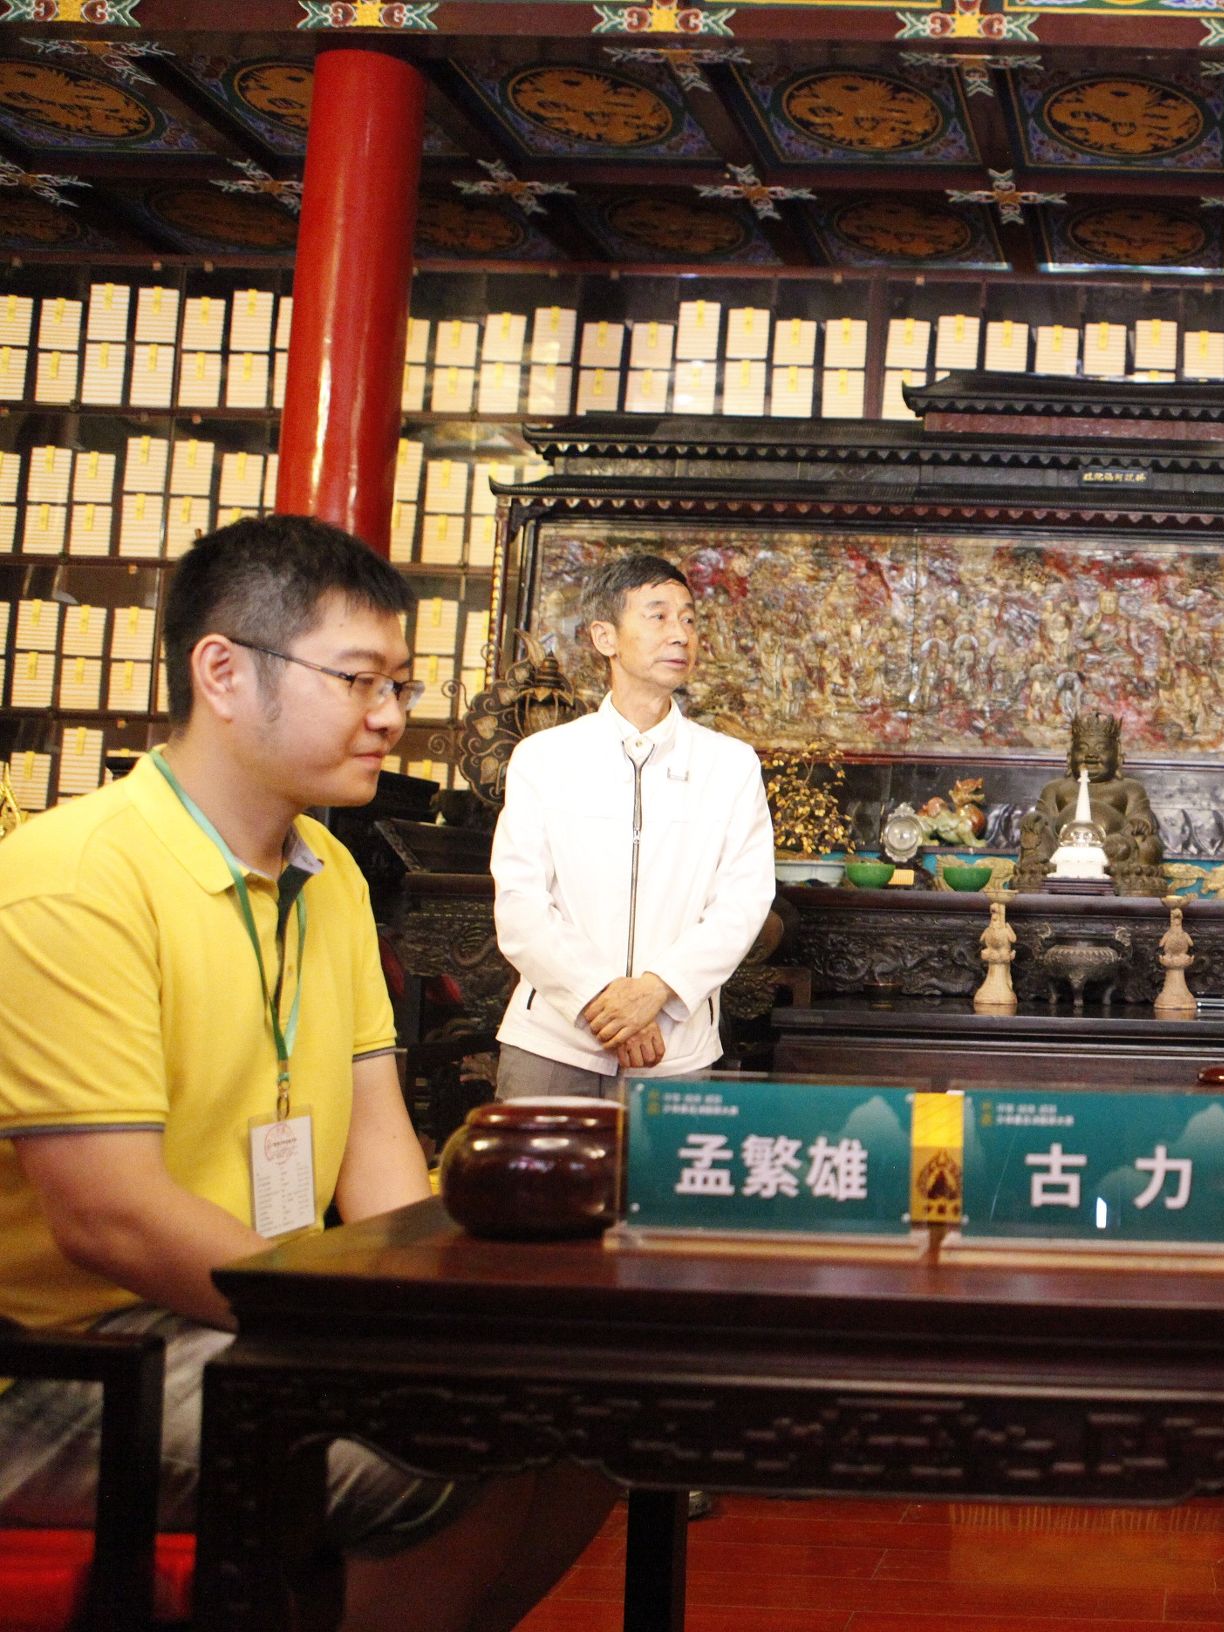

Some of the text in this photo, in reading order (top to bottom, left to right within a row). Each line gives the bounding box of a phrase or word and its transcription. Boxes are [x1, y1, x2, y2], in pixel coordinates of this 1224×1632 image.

[675, 1134, 868, 1202] 孟繁雄
[1024, 1143, 1193, 1210] 古力
